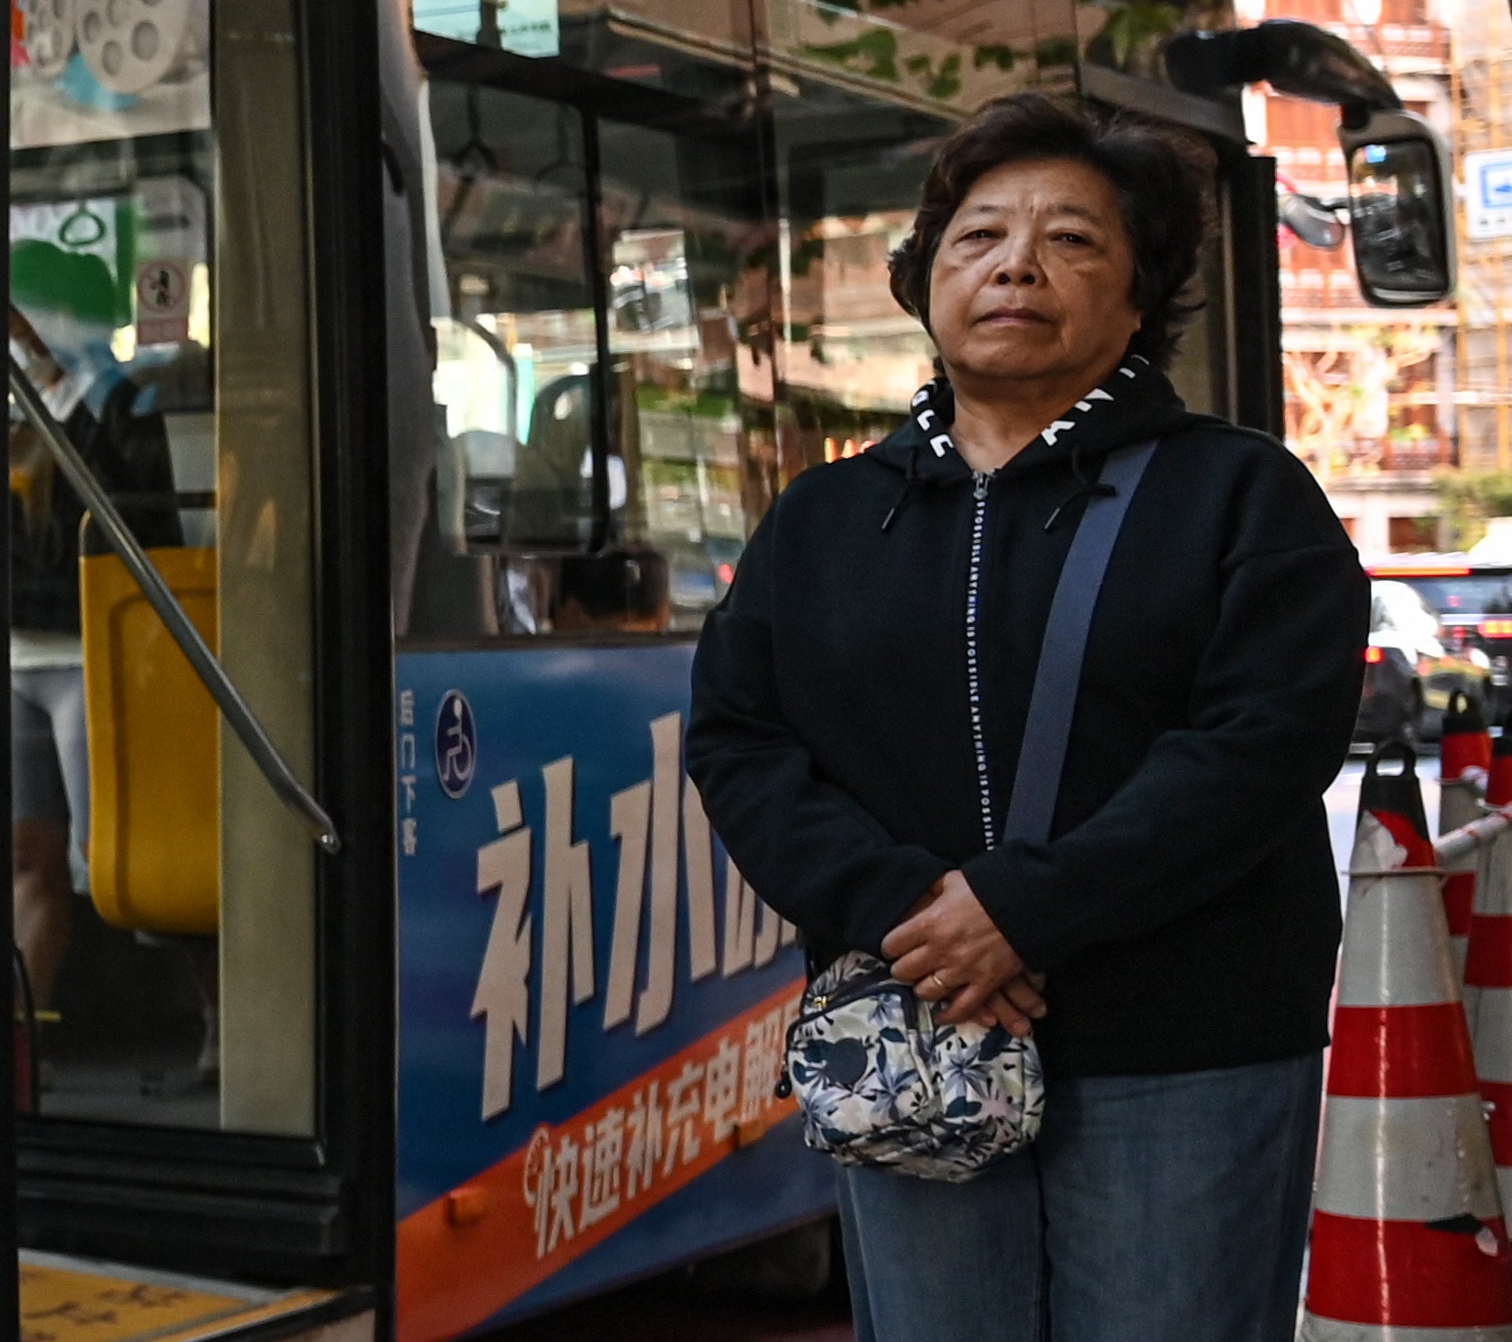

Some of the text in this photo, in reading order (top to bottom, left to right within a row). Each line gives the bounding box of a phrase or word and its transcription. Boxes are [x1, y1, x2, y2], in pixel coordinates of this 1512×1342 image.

[532, 994, 804, 1260] 快速补充电解
